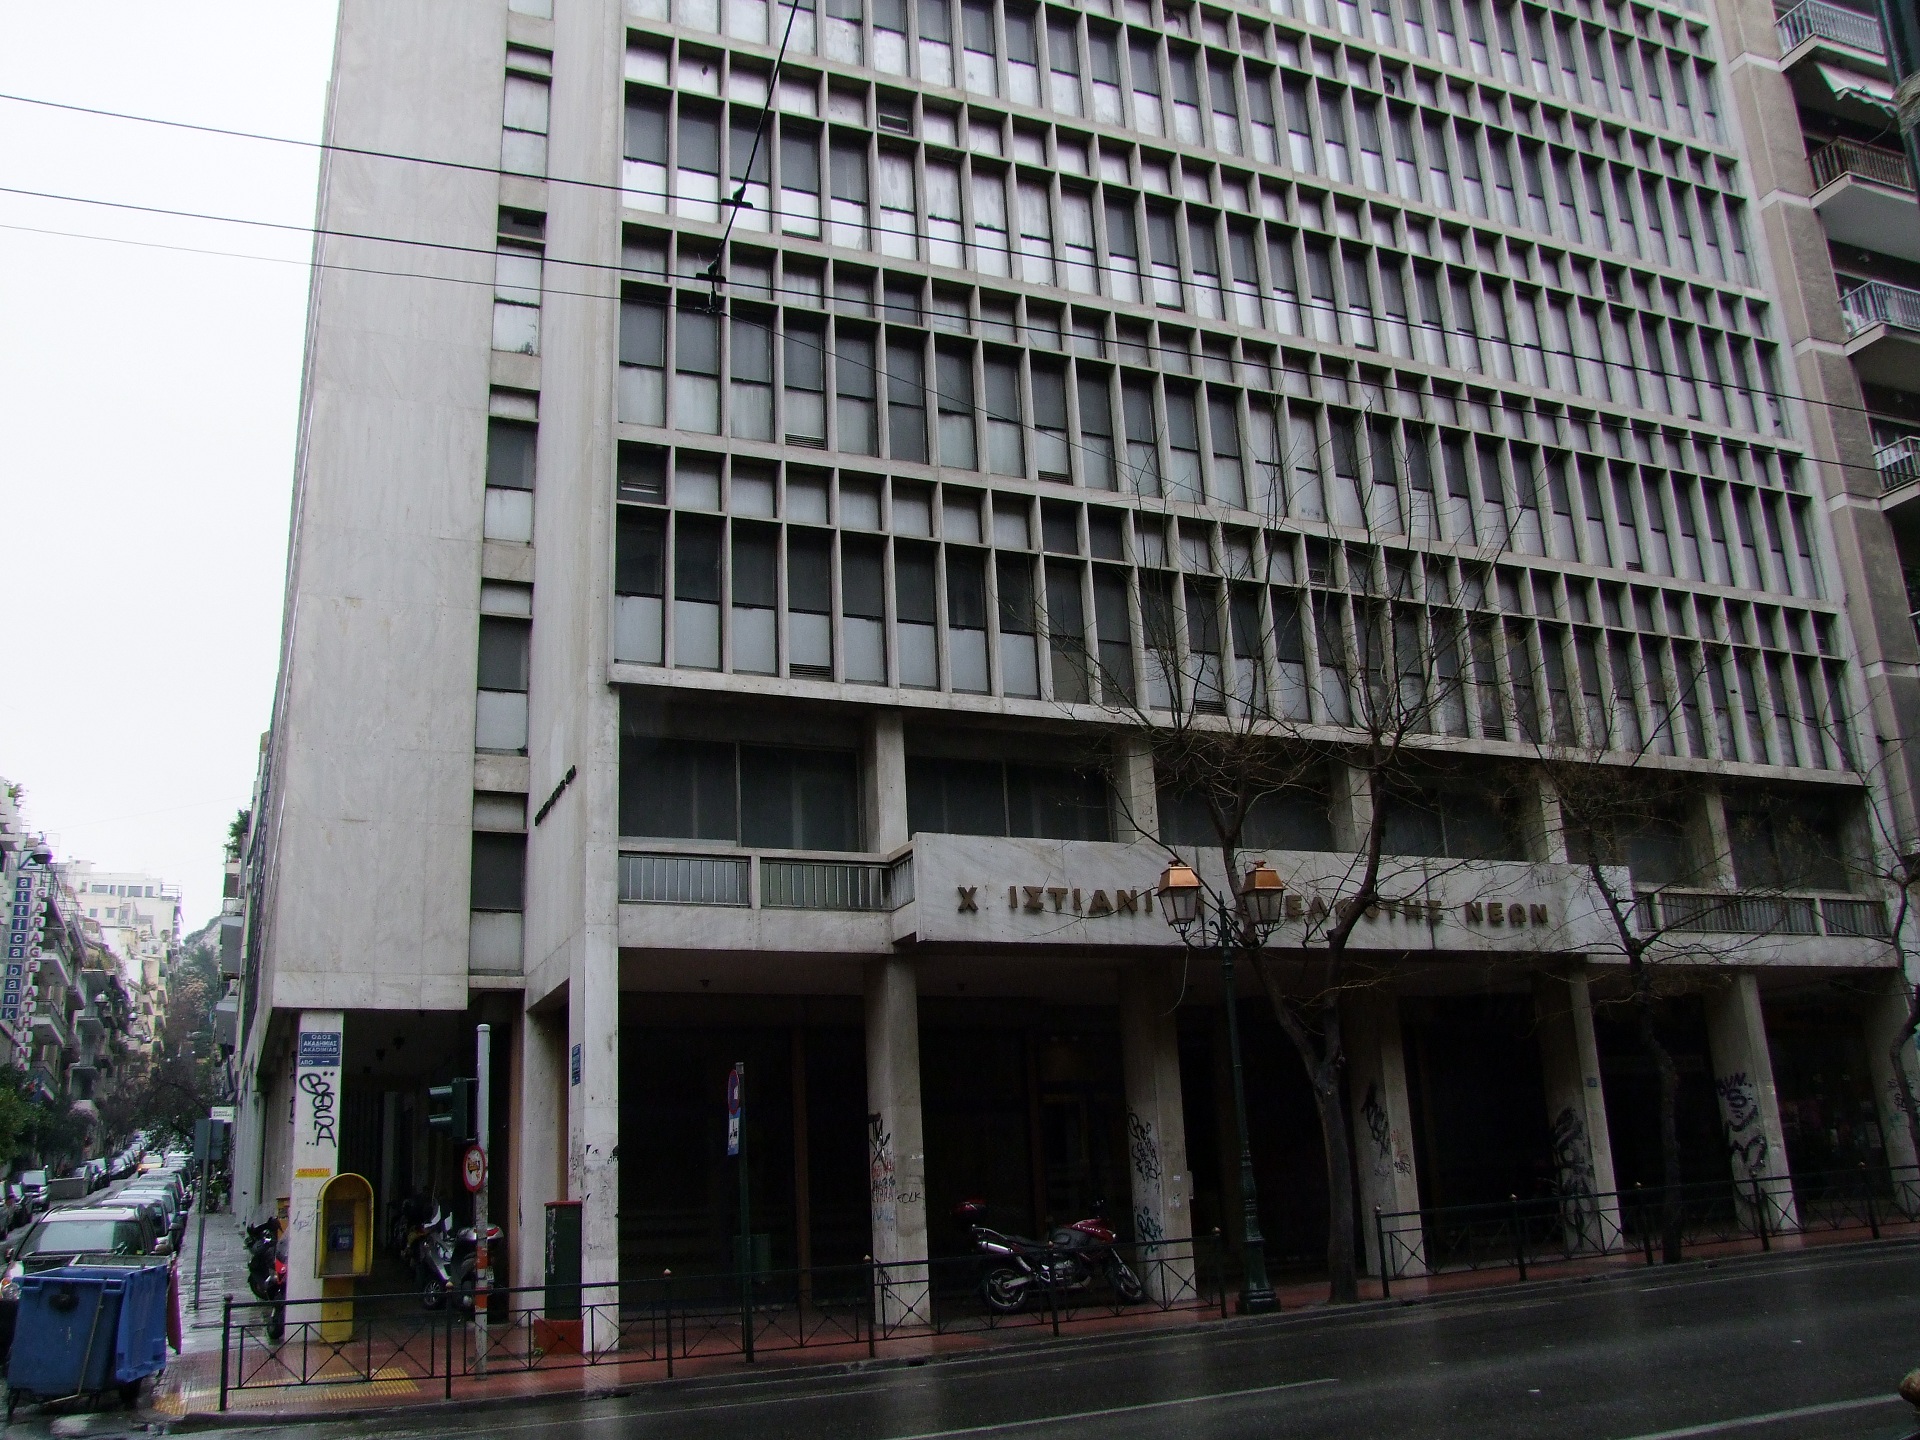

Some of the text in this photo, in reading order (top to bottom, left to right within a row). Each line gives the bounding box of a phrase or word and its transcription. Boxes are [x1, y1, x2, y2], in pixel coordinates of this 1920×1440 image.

[5, 878, 29, 1019] attica bank
[18, 887, 47, 1070] GARAGE ATHINA
